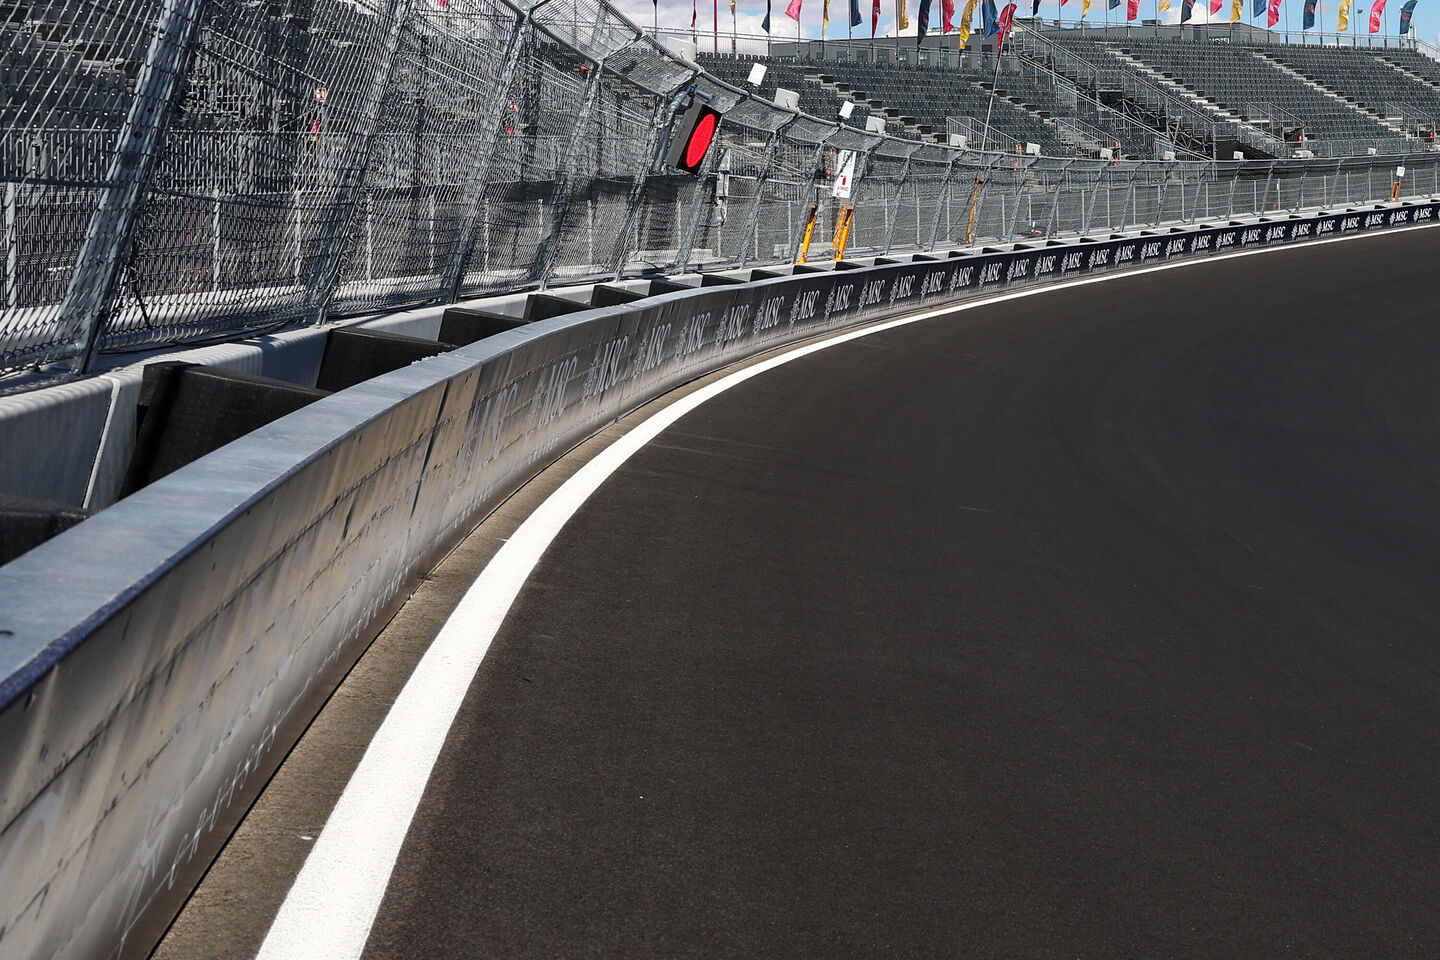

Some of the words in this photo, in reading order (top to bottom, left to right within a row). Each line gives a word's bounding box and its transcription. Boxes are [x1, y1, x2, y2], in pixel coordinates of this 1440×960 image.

[1371, 213, 1384, 225] MSC
[1395, 210, 1408, 222] MSC
[1419, 207, 1432, 218] MSC
[1296, 223, 1311, 236] MSC
[1322, 220, 1335, 232] MSC
[1346, 217, 1360, 228] MSC
[1222, 232, 1236, 246] MSC
[1247, 229, 1261, 243] MSC
[1271, 226, 1285, 239] MSC
[1147, 242, 1161, 257] MSC
[1172, 238, 1186, 253] MSC
[1197, 235, 1211, 250] MSC
[1068, 252, 1083, 269] MSC
[1095, 248, 1110, 265] MSC
[1121, 244, 1136, 261] MSC
[986, 262, 1002, 282] MSC
[1014, 258, 1030, 278] MSC
[1041, 255, 1057, 273] MSC
[928, 271, 945, 294] MSC
[957, 266, 974, 287] MSC
[865, 279, 885, 305] MSC
[897, 274, 916, 299] MSC
[798, 290, 820, 320] MSC
[833, 284, 854, 312] MSC
[761, 296, 784, 330] MSC
